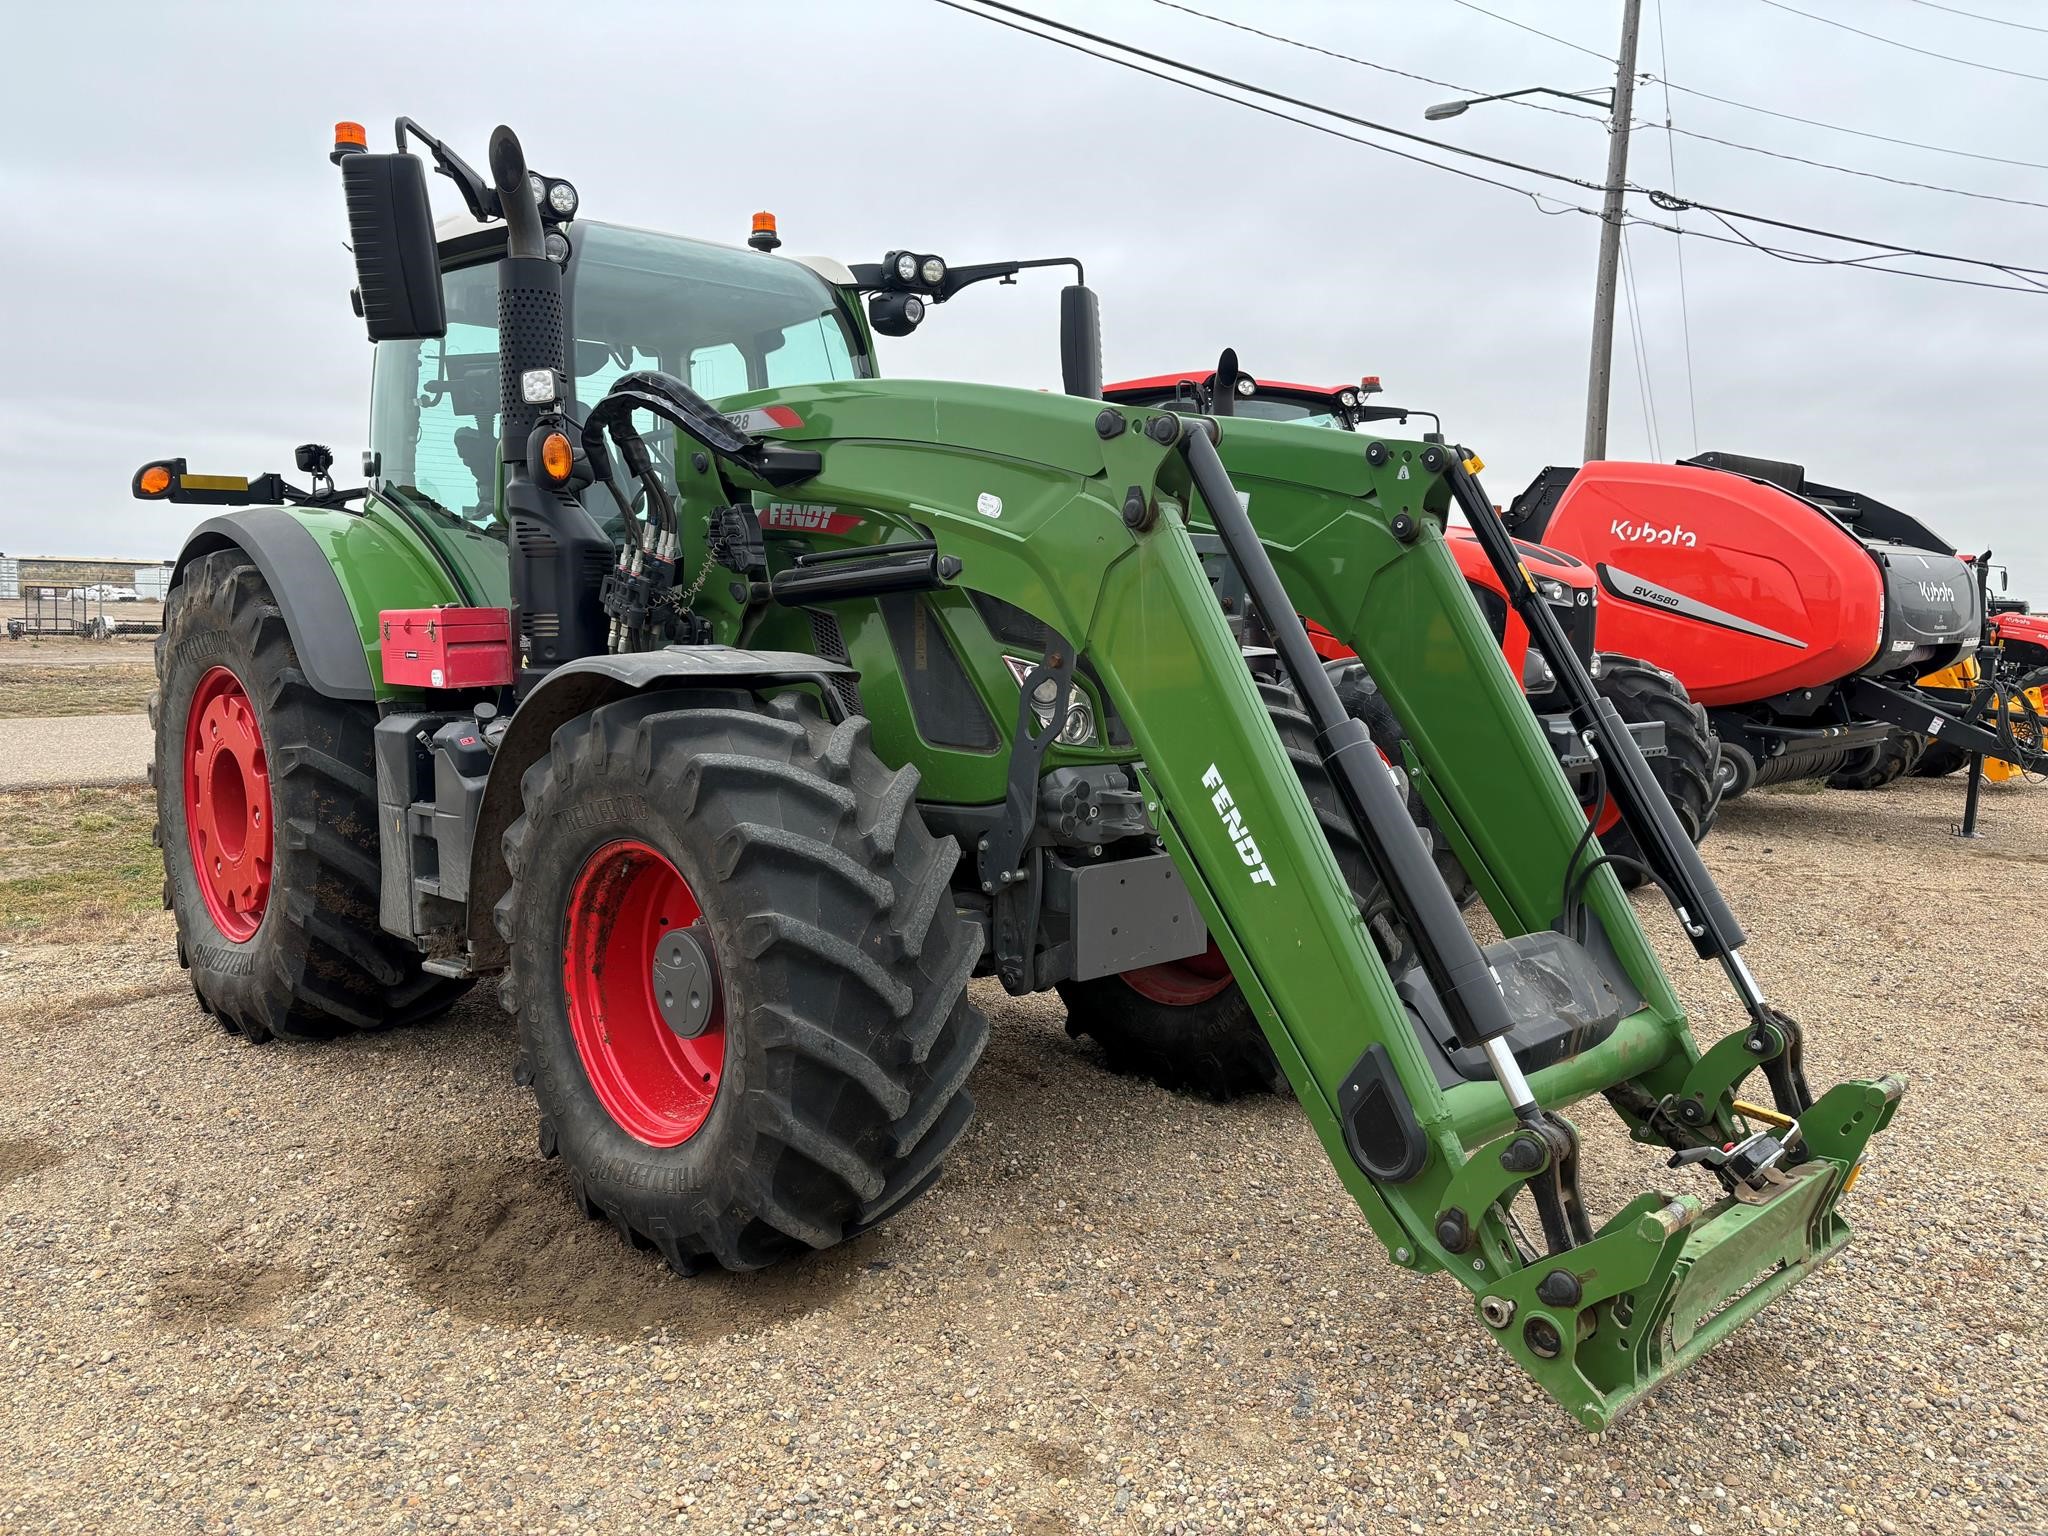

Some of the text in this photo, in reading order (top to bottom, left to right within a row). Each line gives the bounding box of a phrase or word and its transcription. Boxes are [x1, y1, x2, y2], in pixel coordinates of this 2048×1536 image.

[769, 502, 837, 529] FENDT
[1610, 519, 1697, 548] Kubota
[1632, 585, 1680, 607] BV4580
[1918, 581, 1954, 602] Kubota
[2005, 616, 2030, 625] Kubota
[175, 629, 232, 666] TRELLEBORG
[552, 793, 648, 836] TRELLEBORG
[1201, 762, 1277, 887] FENDT
[193, 943, 256, 977] TRELLEBORG
[589, 1155, 704, 1194] TRELLEBORG
